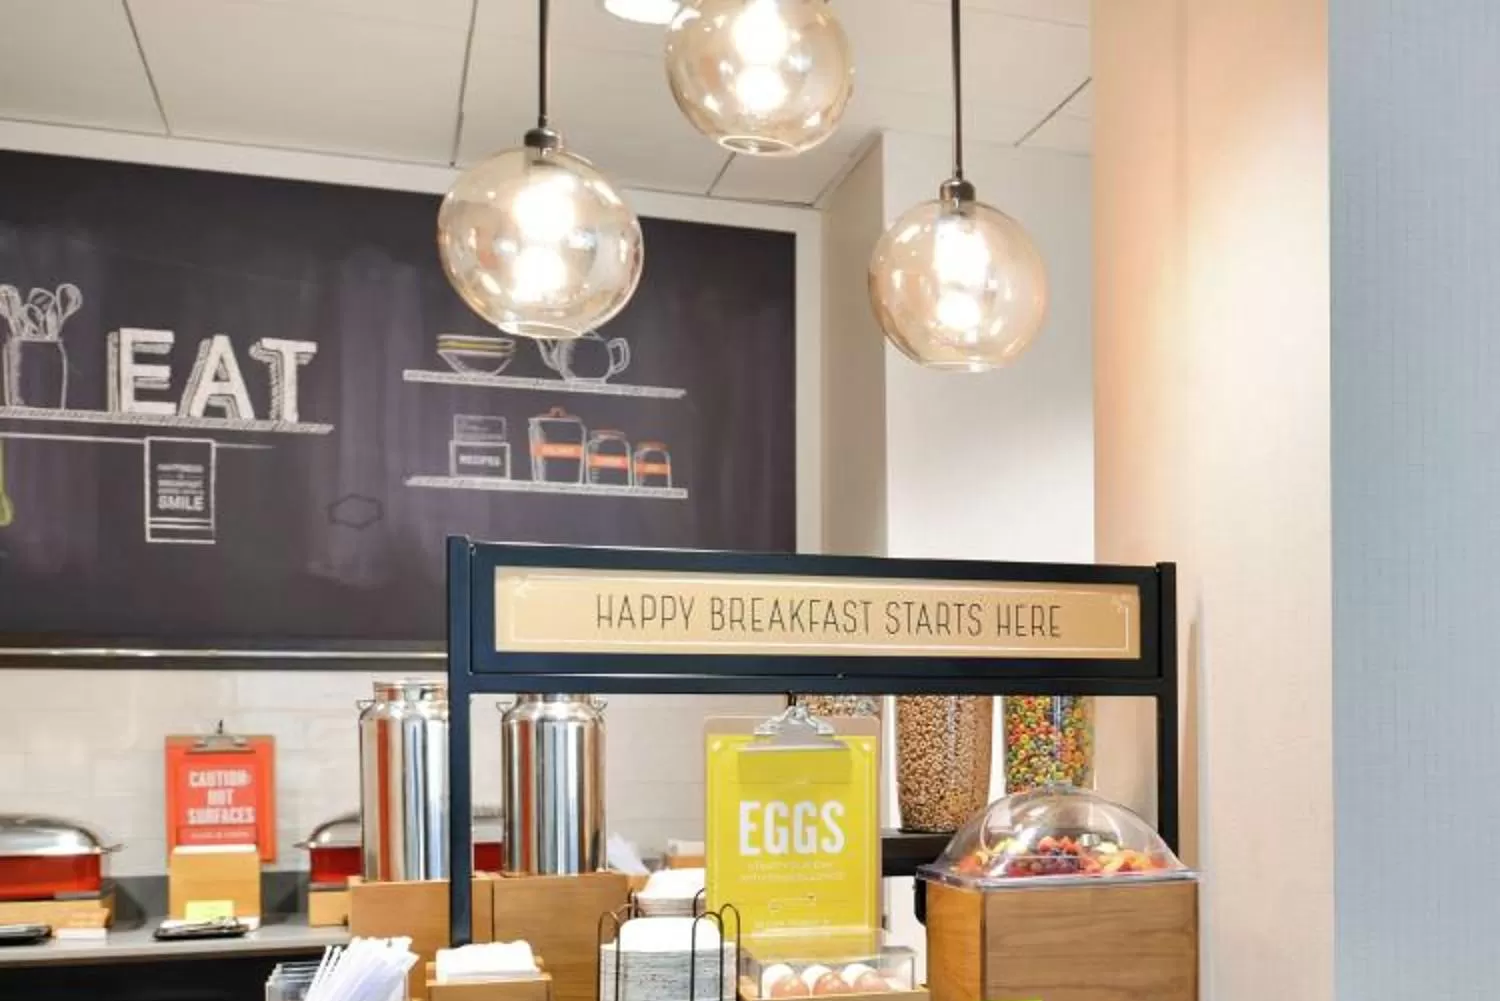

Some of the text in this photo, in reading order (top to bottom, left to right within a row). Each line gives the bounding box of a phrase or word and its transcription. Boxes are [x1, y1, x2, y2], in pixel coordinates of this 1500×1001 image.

[107, 327, 318, 424] EAT
[157, 495, 204, 511] SMILE
[596, 593, 1063, 638] HAPPY BREAKFAST STARTS HERE
[187, 806, 256, 825] SURFACES
[739, 800, 846, 857] EGGS
